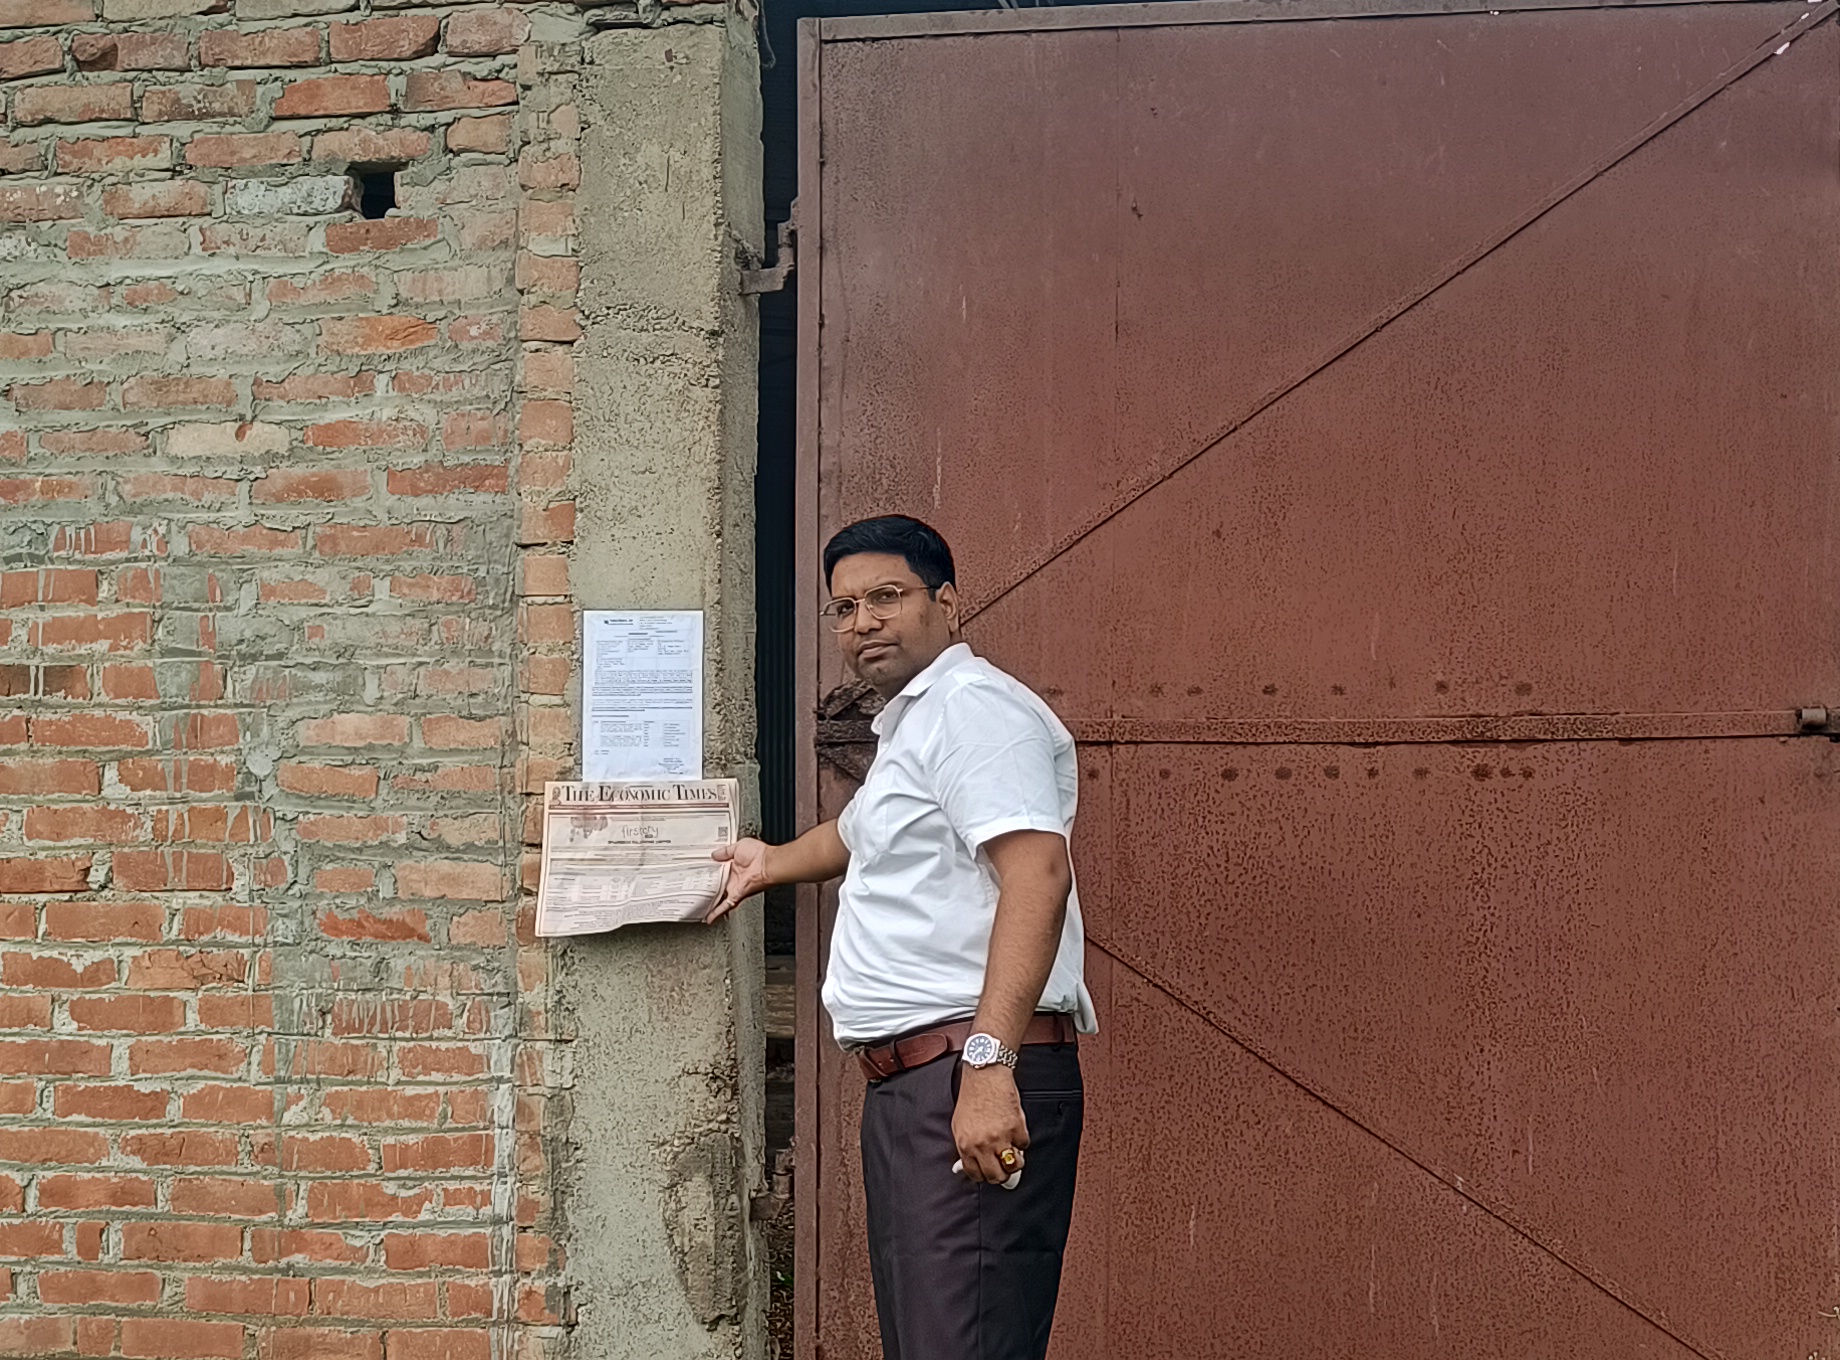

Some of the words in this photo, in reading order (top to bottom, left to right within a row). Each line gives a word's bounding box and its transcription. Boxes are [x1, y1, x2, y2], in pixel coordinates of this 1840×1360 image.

[562, 785, 595, 802] THE
[599, 785, 671, 802] ECONOMIC
[673, 784, 717, 801] TIMES
